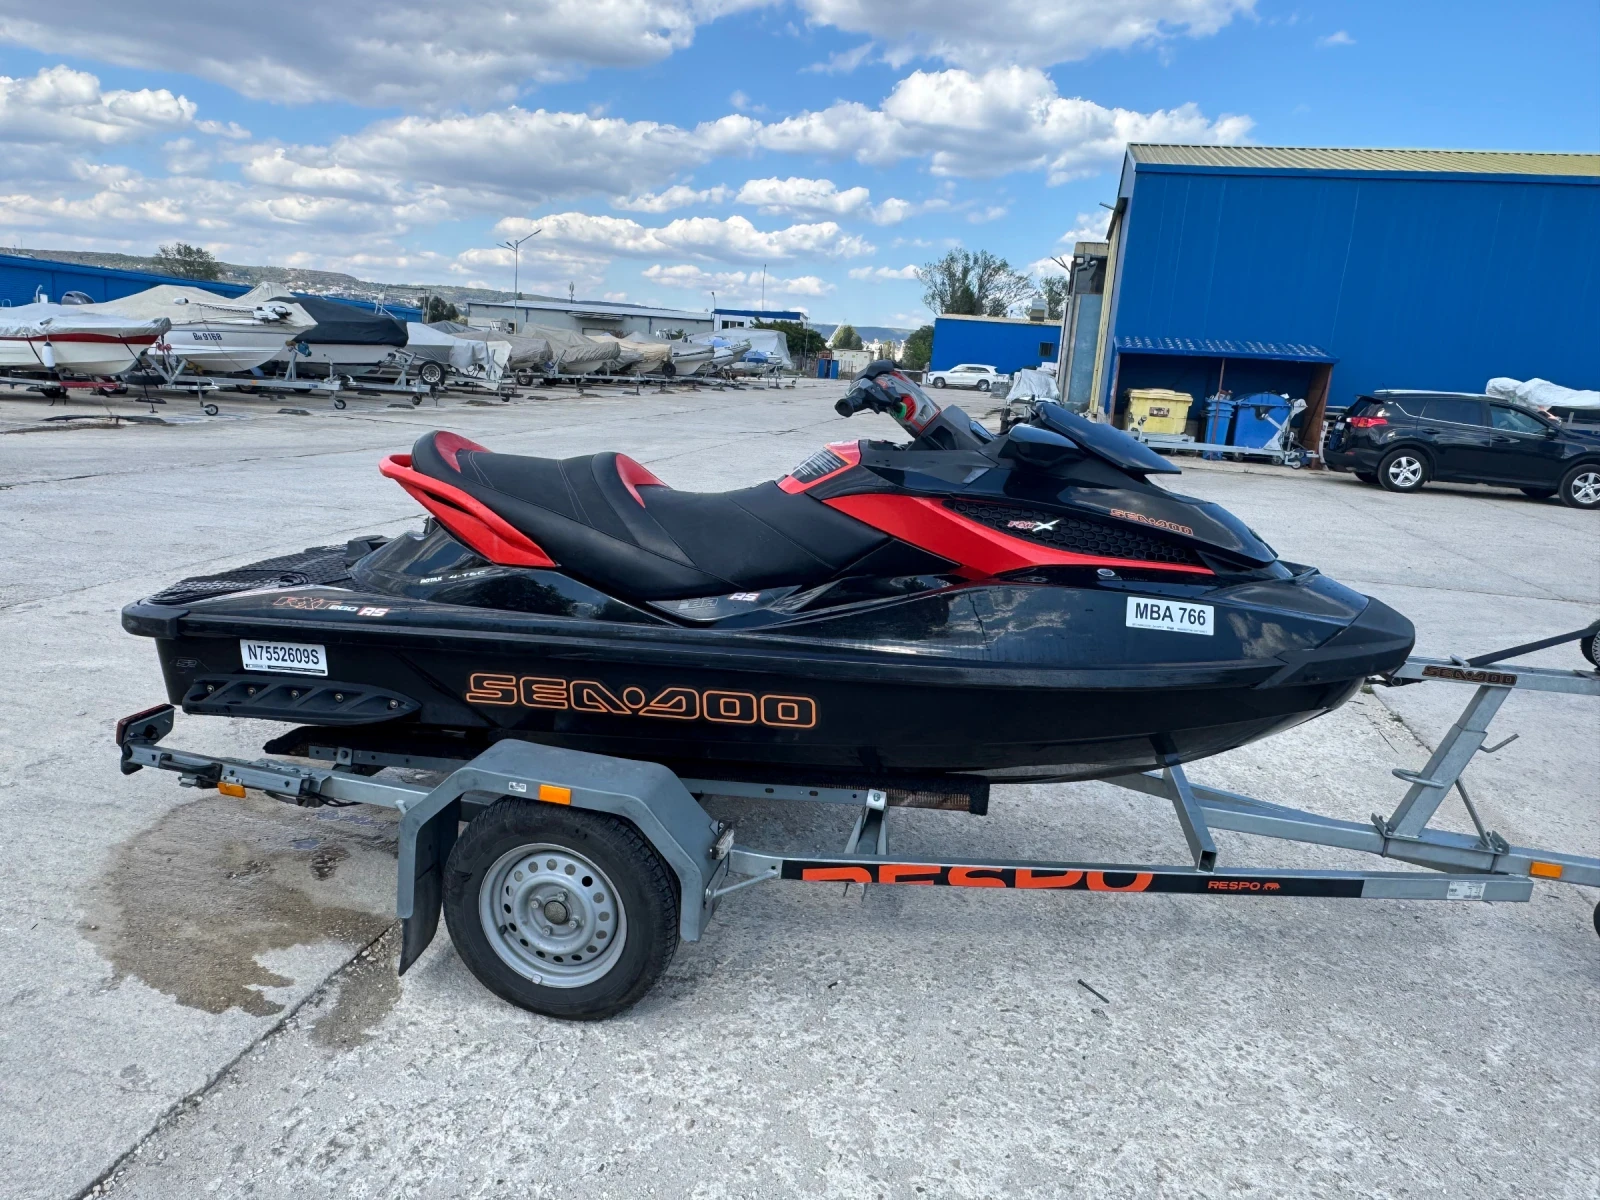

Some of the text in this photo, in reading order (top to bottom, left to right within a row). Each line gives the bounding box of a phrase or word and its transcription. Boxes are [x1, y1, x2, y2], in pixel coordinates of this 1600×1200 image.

[1135, 602, 1206, 626] MBA 766
[247, 644, 320, 665] N7552609S
[1207, 880, 1261, 891] RESPO
